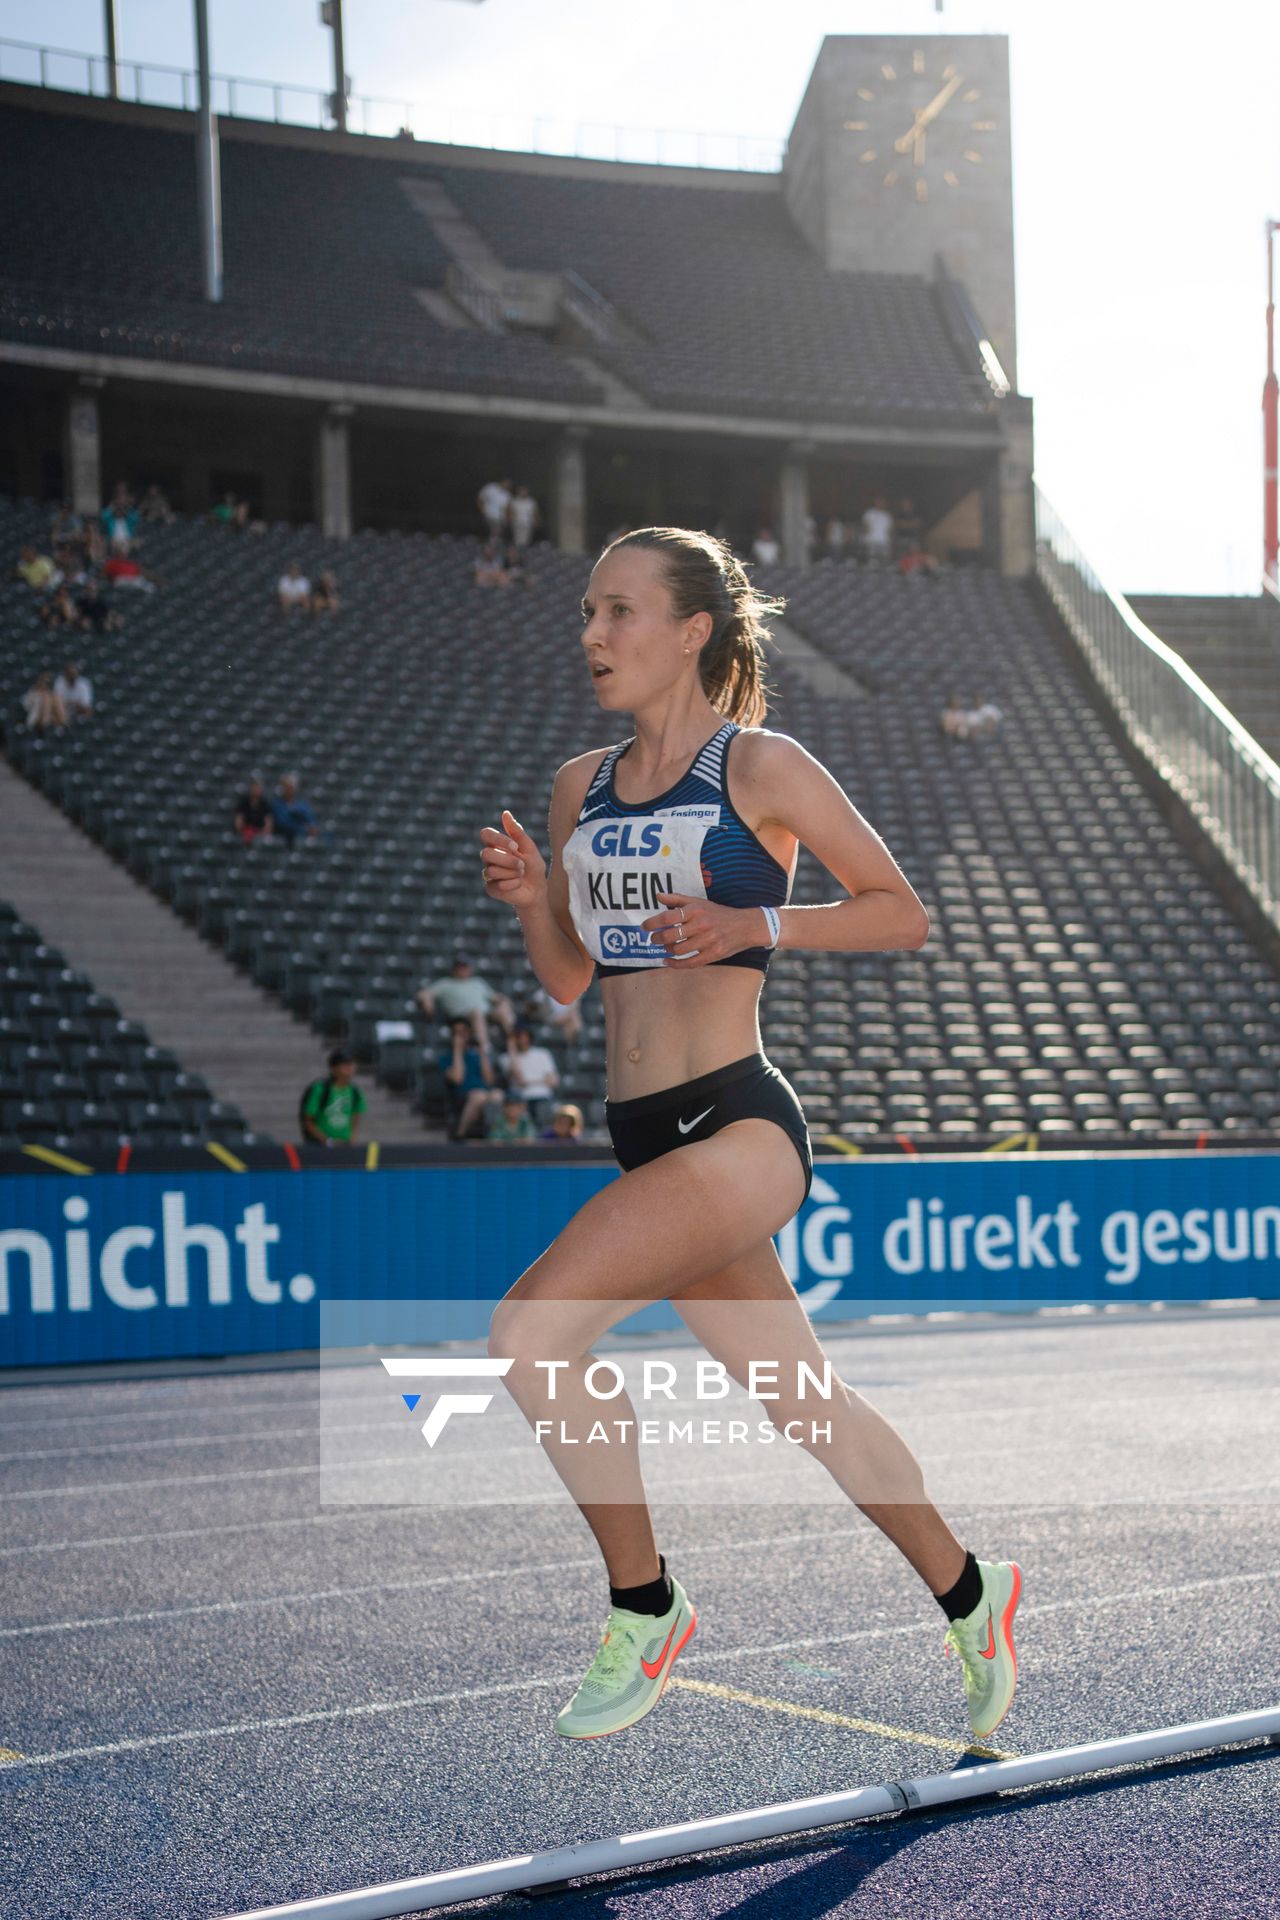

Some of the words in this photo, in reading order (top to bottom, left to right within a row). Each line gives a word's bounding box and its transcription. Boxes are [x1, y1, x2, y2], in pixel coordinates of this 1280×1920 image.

[588, 872, 674, 910] KLEIN
[0, 1191, 316, 1314] nicht.
[883, 1195, 1081, 1275] direkt
